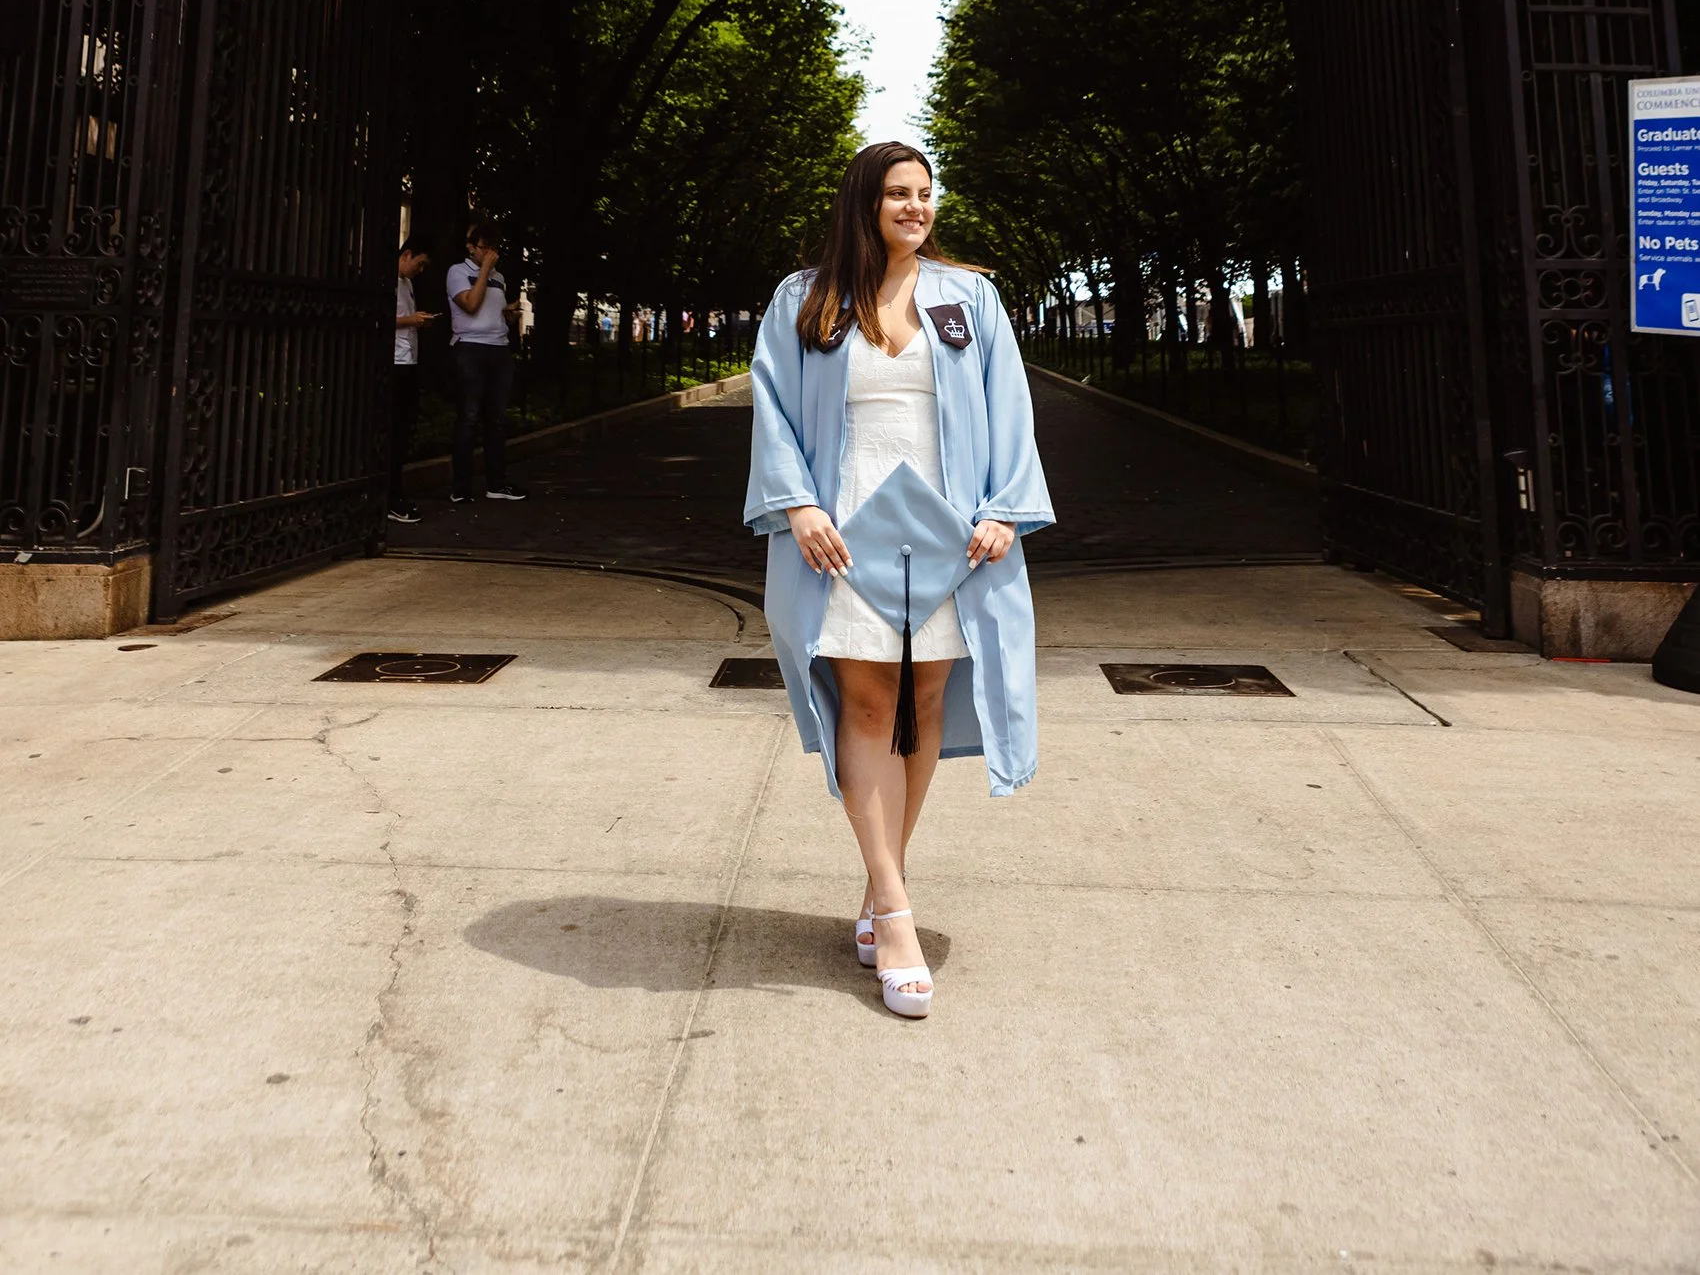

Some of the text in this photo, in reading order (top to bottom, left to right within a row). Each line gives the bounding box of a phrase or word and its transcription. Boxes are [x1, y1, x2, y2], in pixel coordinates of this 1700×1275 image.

[1636, 87, 1682, 98] COLUMBIA
[1638, 162, 1690, 176] Guests
[1639, 236, 1699, 251] No Pets
[1639, 254, 1665, 262] Service
